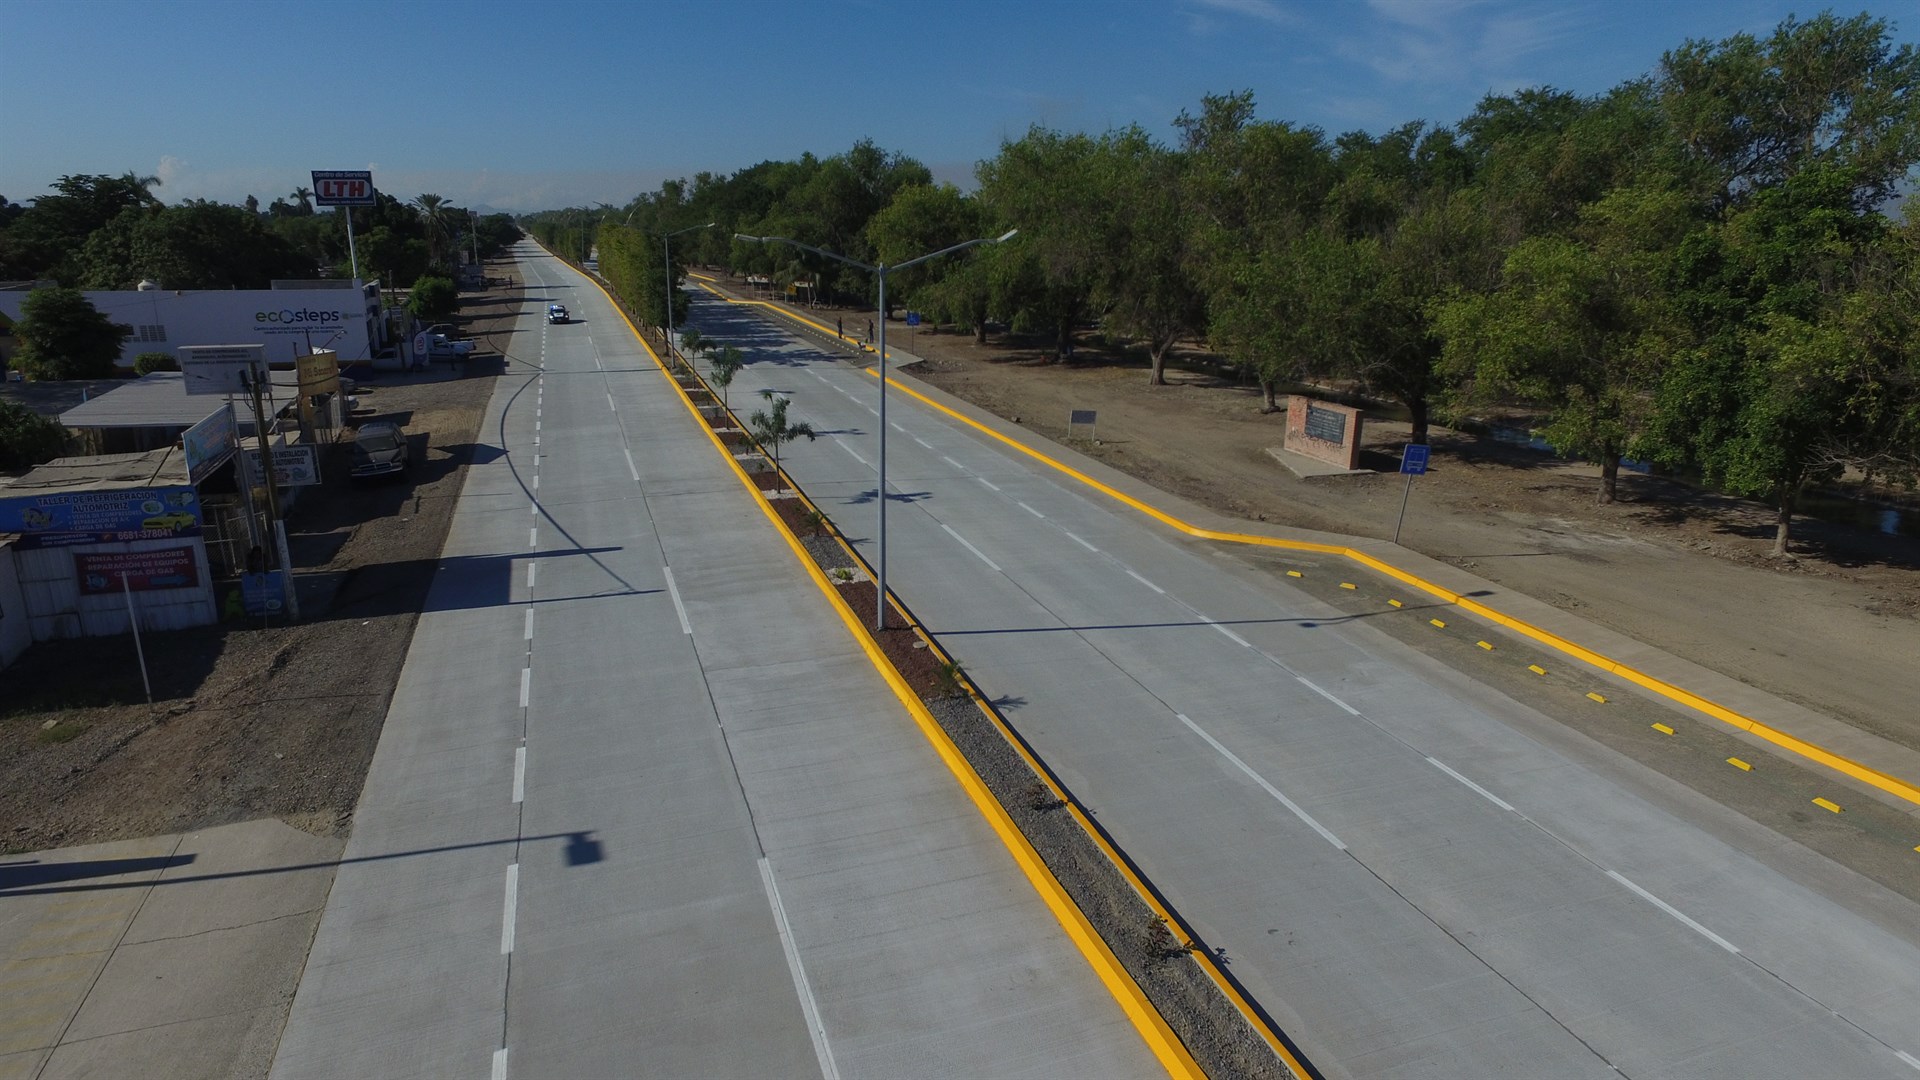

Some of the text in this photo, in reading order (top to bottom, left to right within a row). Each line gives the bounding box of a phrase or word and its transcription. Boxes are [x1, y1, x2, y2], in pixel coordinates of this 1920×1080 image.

[323, 181, 364, 197] LTH
[255, 308, 339, 324] ecosteps
[37, 491, 157, 507] TALLER DE REFRIGERACION
[72, 502, 129, 513] AUTOMOTRIZ
[117, 529, 173, 540] 6681-378041
[126, 551, 185, 560] COMPRESORES
[154, 558, 189, 567] EQUIPOS
[114, 569, 144, 577] CRGA
